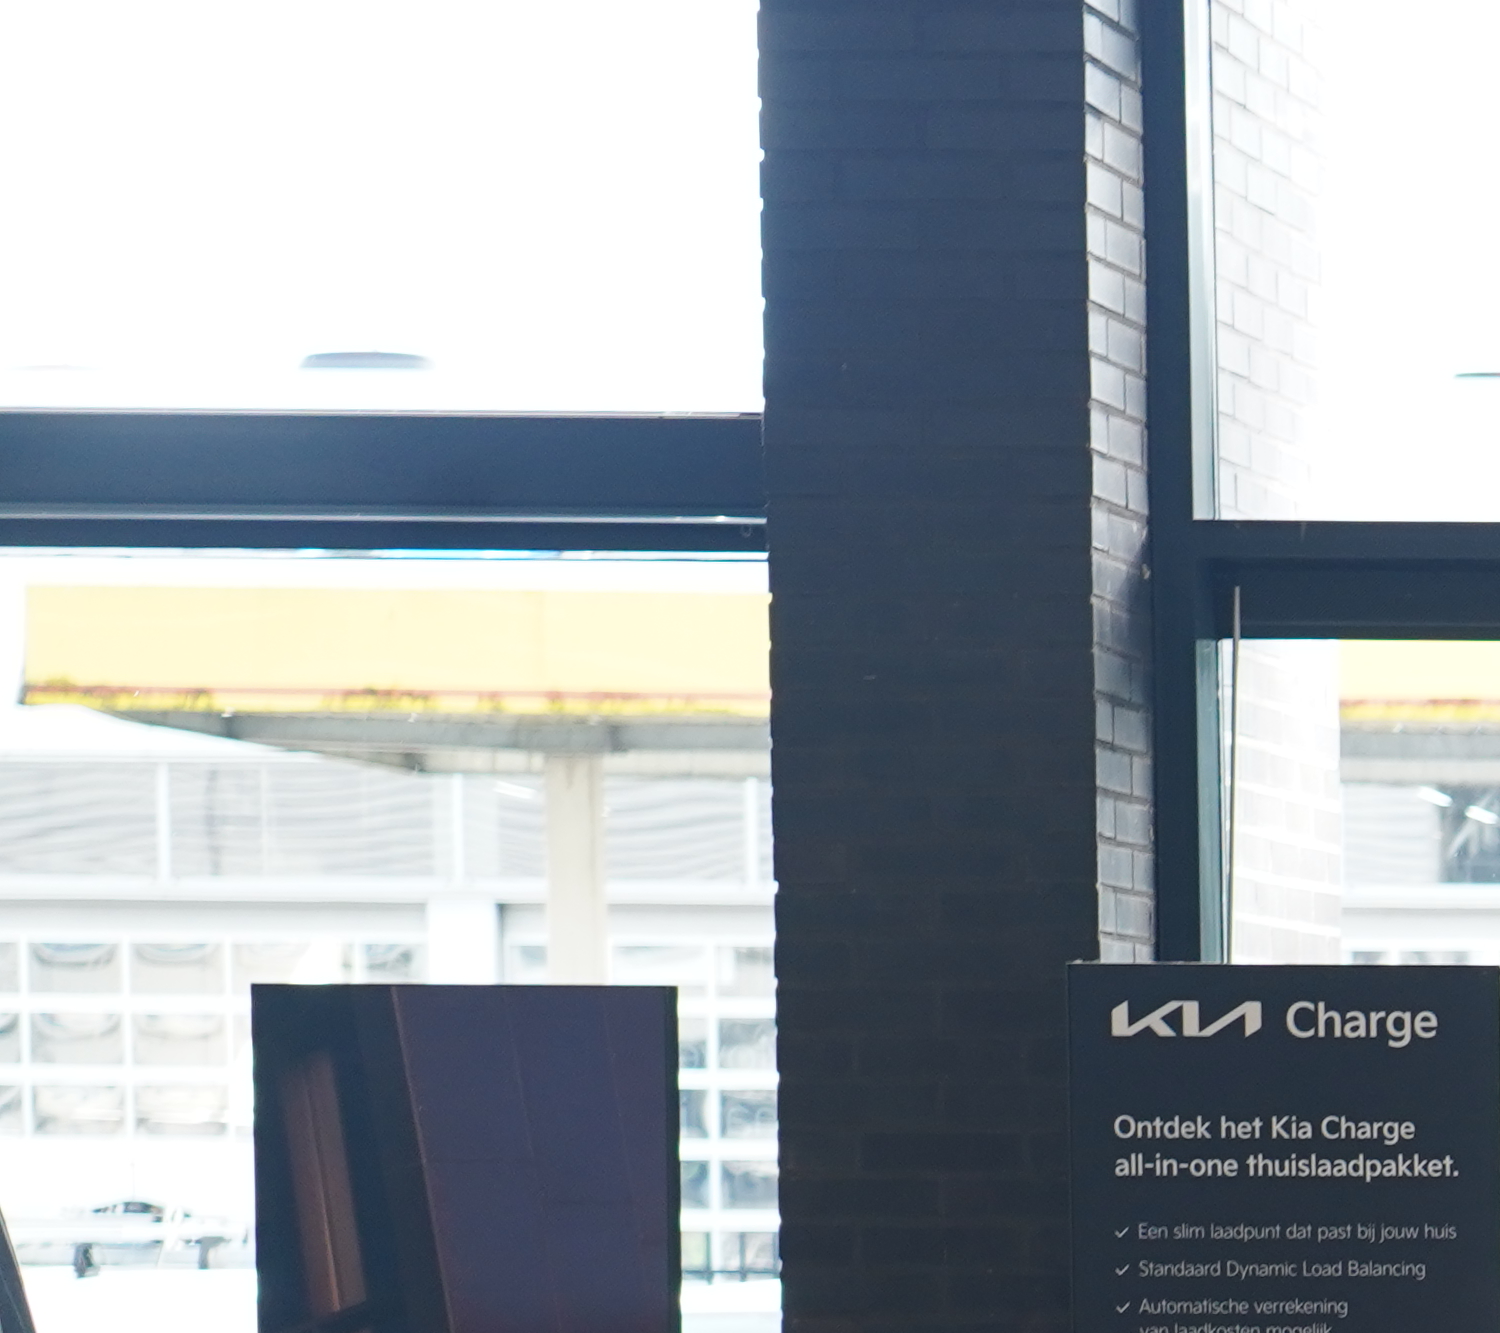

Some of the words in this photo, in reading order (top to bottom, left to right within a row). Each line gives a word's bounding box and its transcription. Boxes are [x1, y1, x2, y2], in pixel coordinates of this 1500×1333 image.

[1111, 1001, 1262, 1037] KIA
[1287, 1001, 1437, 1048] Charge
[1114, 1115, 1211, 1139] Ontdek
[1221, 1116, 1263, 1139] het
[1272, 1116, 1312, 1139] Kia
[1321, 1116, 1415, 1145] Charge
[1115, 1153, 1238, 1176] all-in-one
[1246, 1153, 1458, 1182] thuislaadpakket.
[1138, 1223, 1168, 1239] Een
[1174, 1223, 1204, 1239] slim
[1211, 1223, 1280, 1242] laadpunt
[1286, 1223, 1311, 1239] dat
[1318, 1224, 1352, 1242] past
[1358, 1223, 1375, 1243] bij
[1379, 1224, 1419, 1243] jouw
[1425, 1223, 1457, 1239] huis
[1139, 1260, 1220, 1277] Standaard
[1227, 1260, 1296, 1280] Dynamic
[1303, 1261, 1342, 1276] Load
[1348, 1260, 1425, 1280] Balancing
[1139, 1298, 1249, 1314] Automatische
[1254, 1298, 1348, 1318] verrekening
